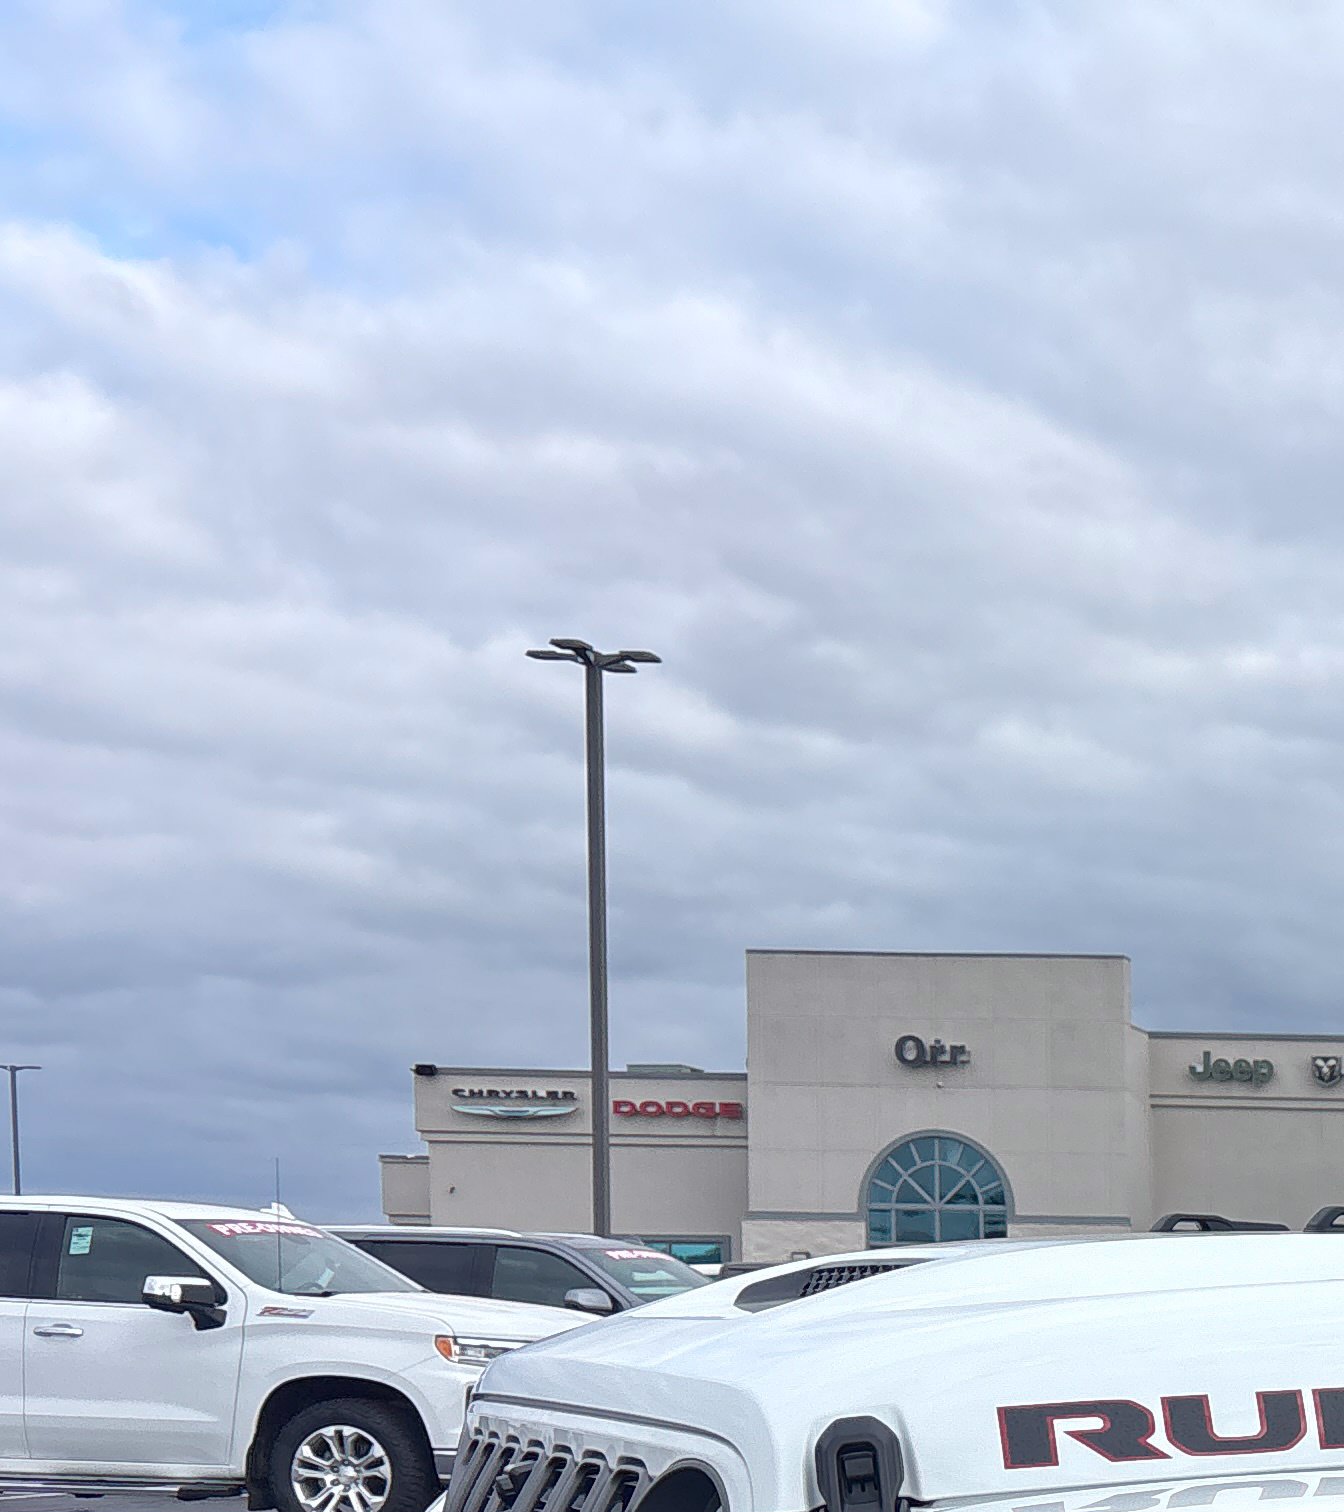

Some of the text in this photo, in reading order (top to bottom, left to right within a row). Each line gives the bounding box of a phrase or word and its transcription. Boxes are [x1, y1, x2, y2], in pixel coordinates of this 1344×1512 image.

[895, 1035, 971, 1068] Orr
[1189, 1051, 1273, 1087] Jeep
[451, 1088, 578, 1100] CHRYSLER
[612, 1099, 741, 1118] DODGE
